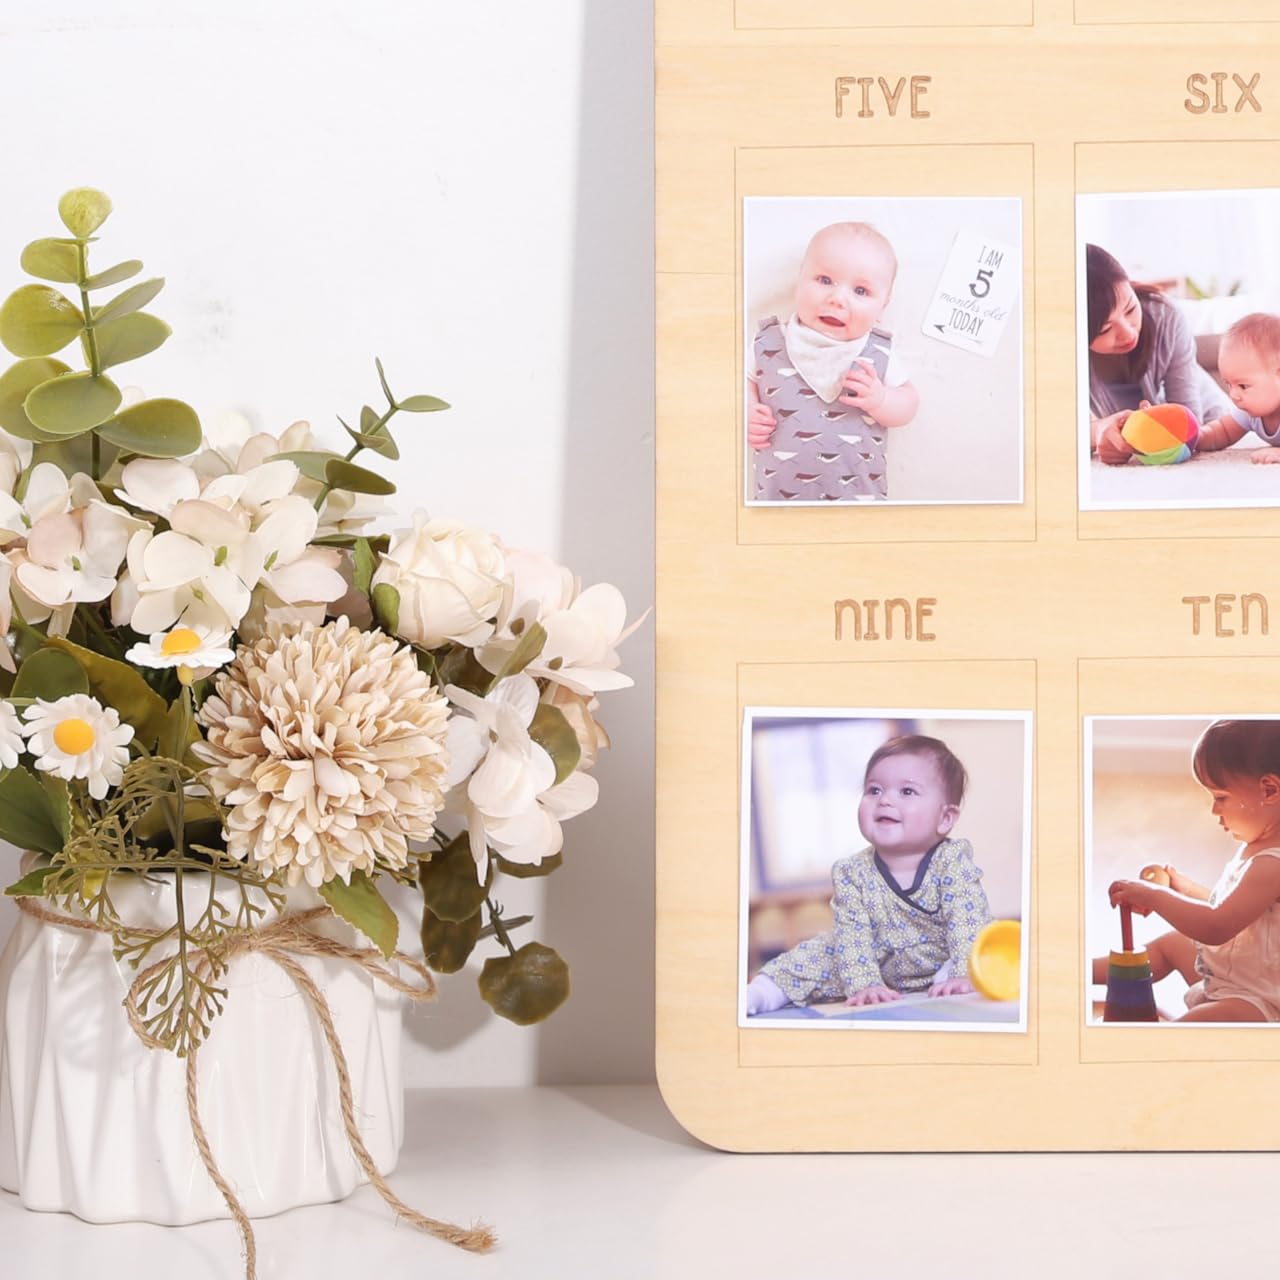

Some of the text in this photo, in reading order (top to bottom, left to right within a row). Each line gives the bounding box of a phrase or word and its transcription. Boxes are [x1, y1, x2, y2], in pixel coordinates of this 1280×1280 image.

[835, 75, 932, 119] FIVE
[1184, 72, 1263, 115] SIX
[978, 245, 1005, 269] I AM
[968, 268, 994, 298] 5
[940, 292, 1008, 321] months old
[948, 307, 985, 337] TODAY
